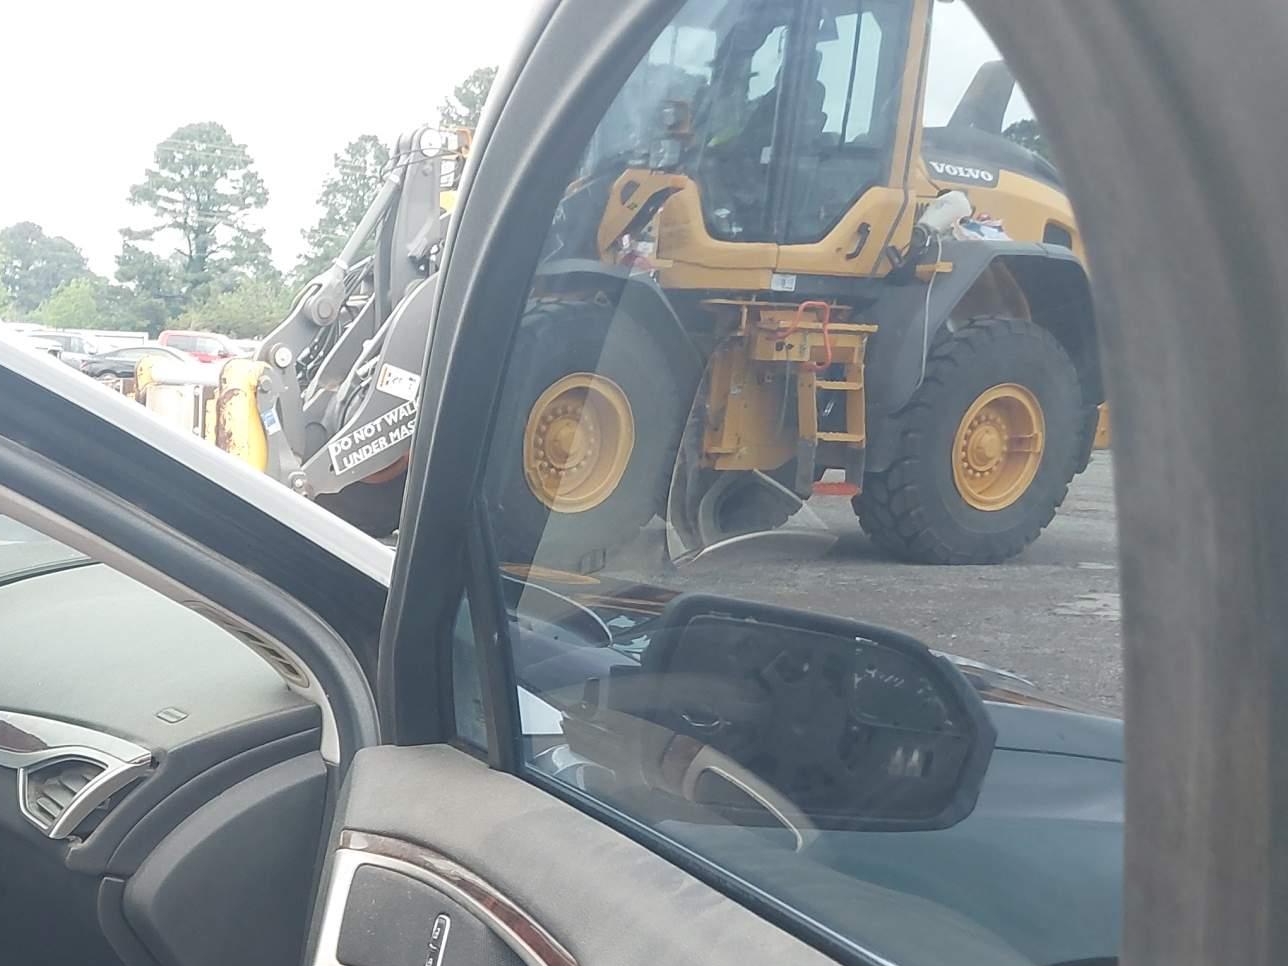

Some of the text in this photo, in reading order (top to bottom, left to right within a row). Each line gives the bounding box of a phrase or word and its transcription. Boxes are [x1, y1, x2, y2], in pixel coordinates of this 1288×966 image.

[929, 161, 993, 182] VOLVO
[333, 437, 352, 456] DO
[353, 420, 382, 444] NOT
[342, 437, 388, 467] UNDER
